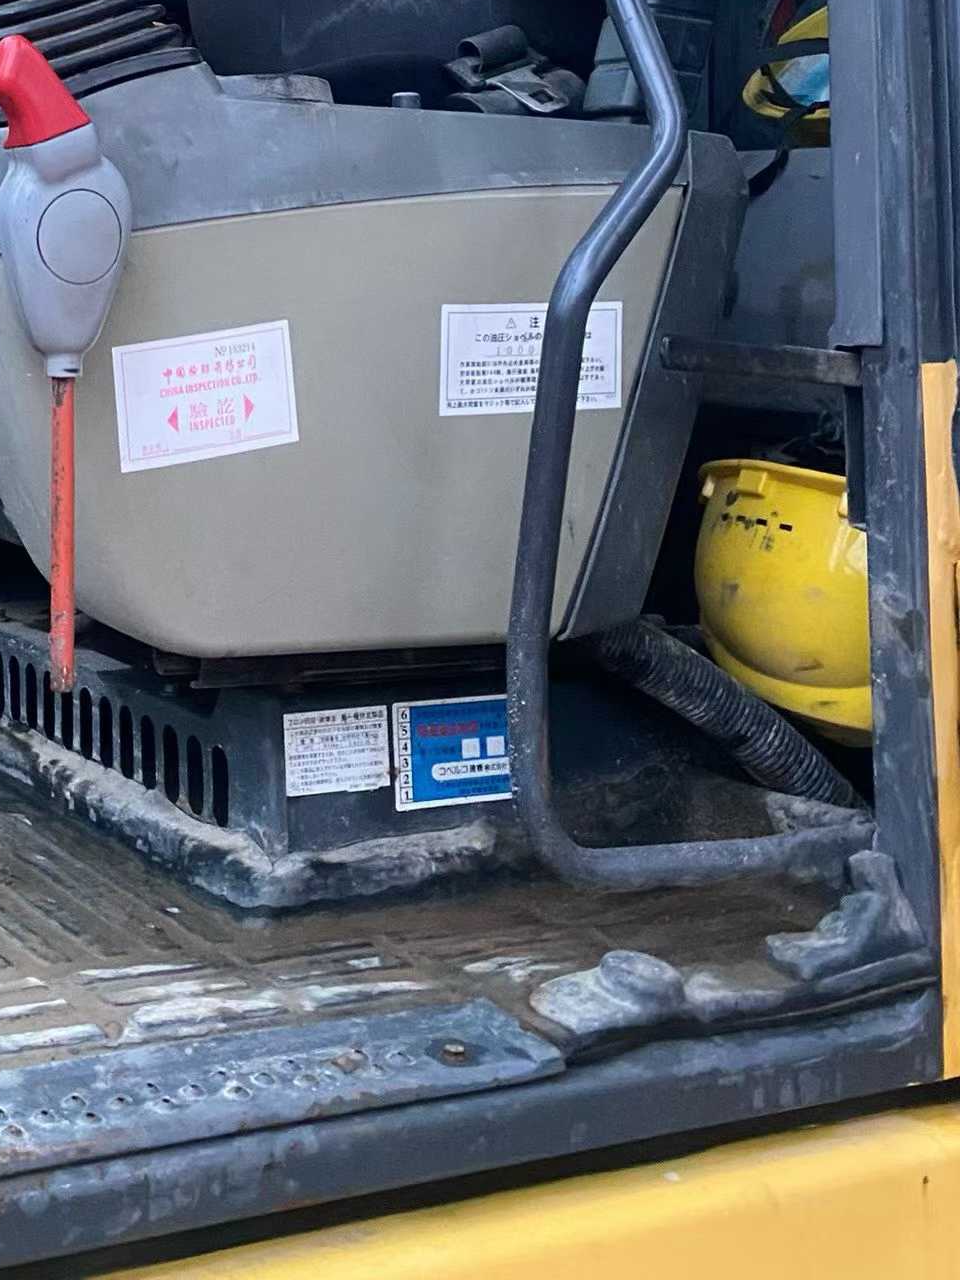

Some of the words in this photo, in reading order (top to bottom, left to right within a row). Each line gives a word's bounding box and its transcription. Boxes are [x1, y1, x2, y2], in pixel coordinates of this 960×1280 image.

[190, 414, 236, 432] INSPECTED
[400, 710, 408, 719] 6
[400, 725, 408, 735] 5
[401, 742, 409, 752] 4
[402, 757, 410, 767] 3
[402, 773, 410, 783] 2
[404, 790, 410, 800] 1
